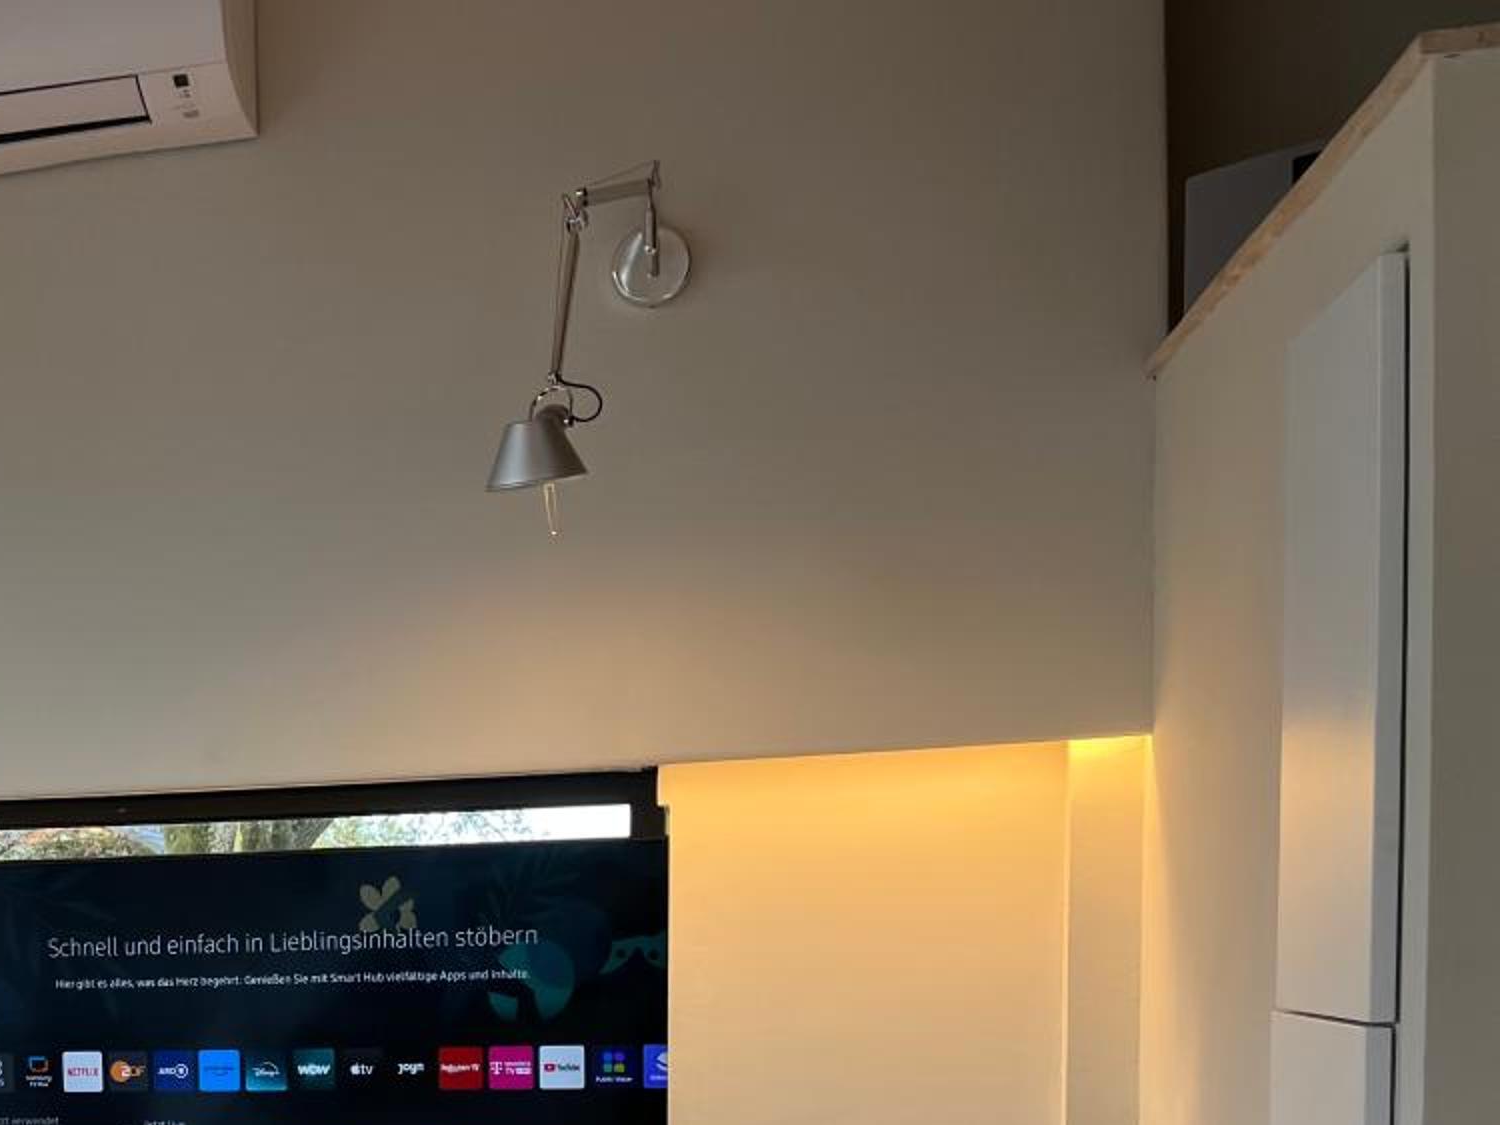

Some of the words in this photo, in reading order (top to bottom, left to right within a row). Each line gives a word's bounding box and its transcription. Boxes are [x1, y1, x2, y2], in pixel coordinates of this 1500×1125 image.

[48, 936, 118, 958] Schnell
[124, 935, 161, 956] und
[167, 933, 239, 955] einfach
[245, 932, 263, 953] in
[270, 928, 449, 955] Lieblingsinhalten
[455, 925, 538, 947] stöbern
[55, 979, 75, 989] Hier
[76, 978, 96, 991] gibt
[97, 979, 108, 989] es
[109, 977, 134, 989] alles,
[135, 979, 155, 988] was
[157, 977, 174, 988] das
[175, 977, 199, 988] Herz
[244, 974, 291, 986] Genießen
[293, 973, 310, 984] Sie
[310, 973, 328, 983] mit
[329, 972, 361, 983] Smart
[363, 972, 384, 982] Hub
[385, 971, 438, 984] vielfältige
[439, 970, 467, 984] Apps
[468, 970, 488, 980] und
[67, 1066, 100, 1077] NETFLIX
